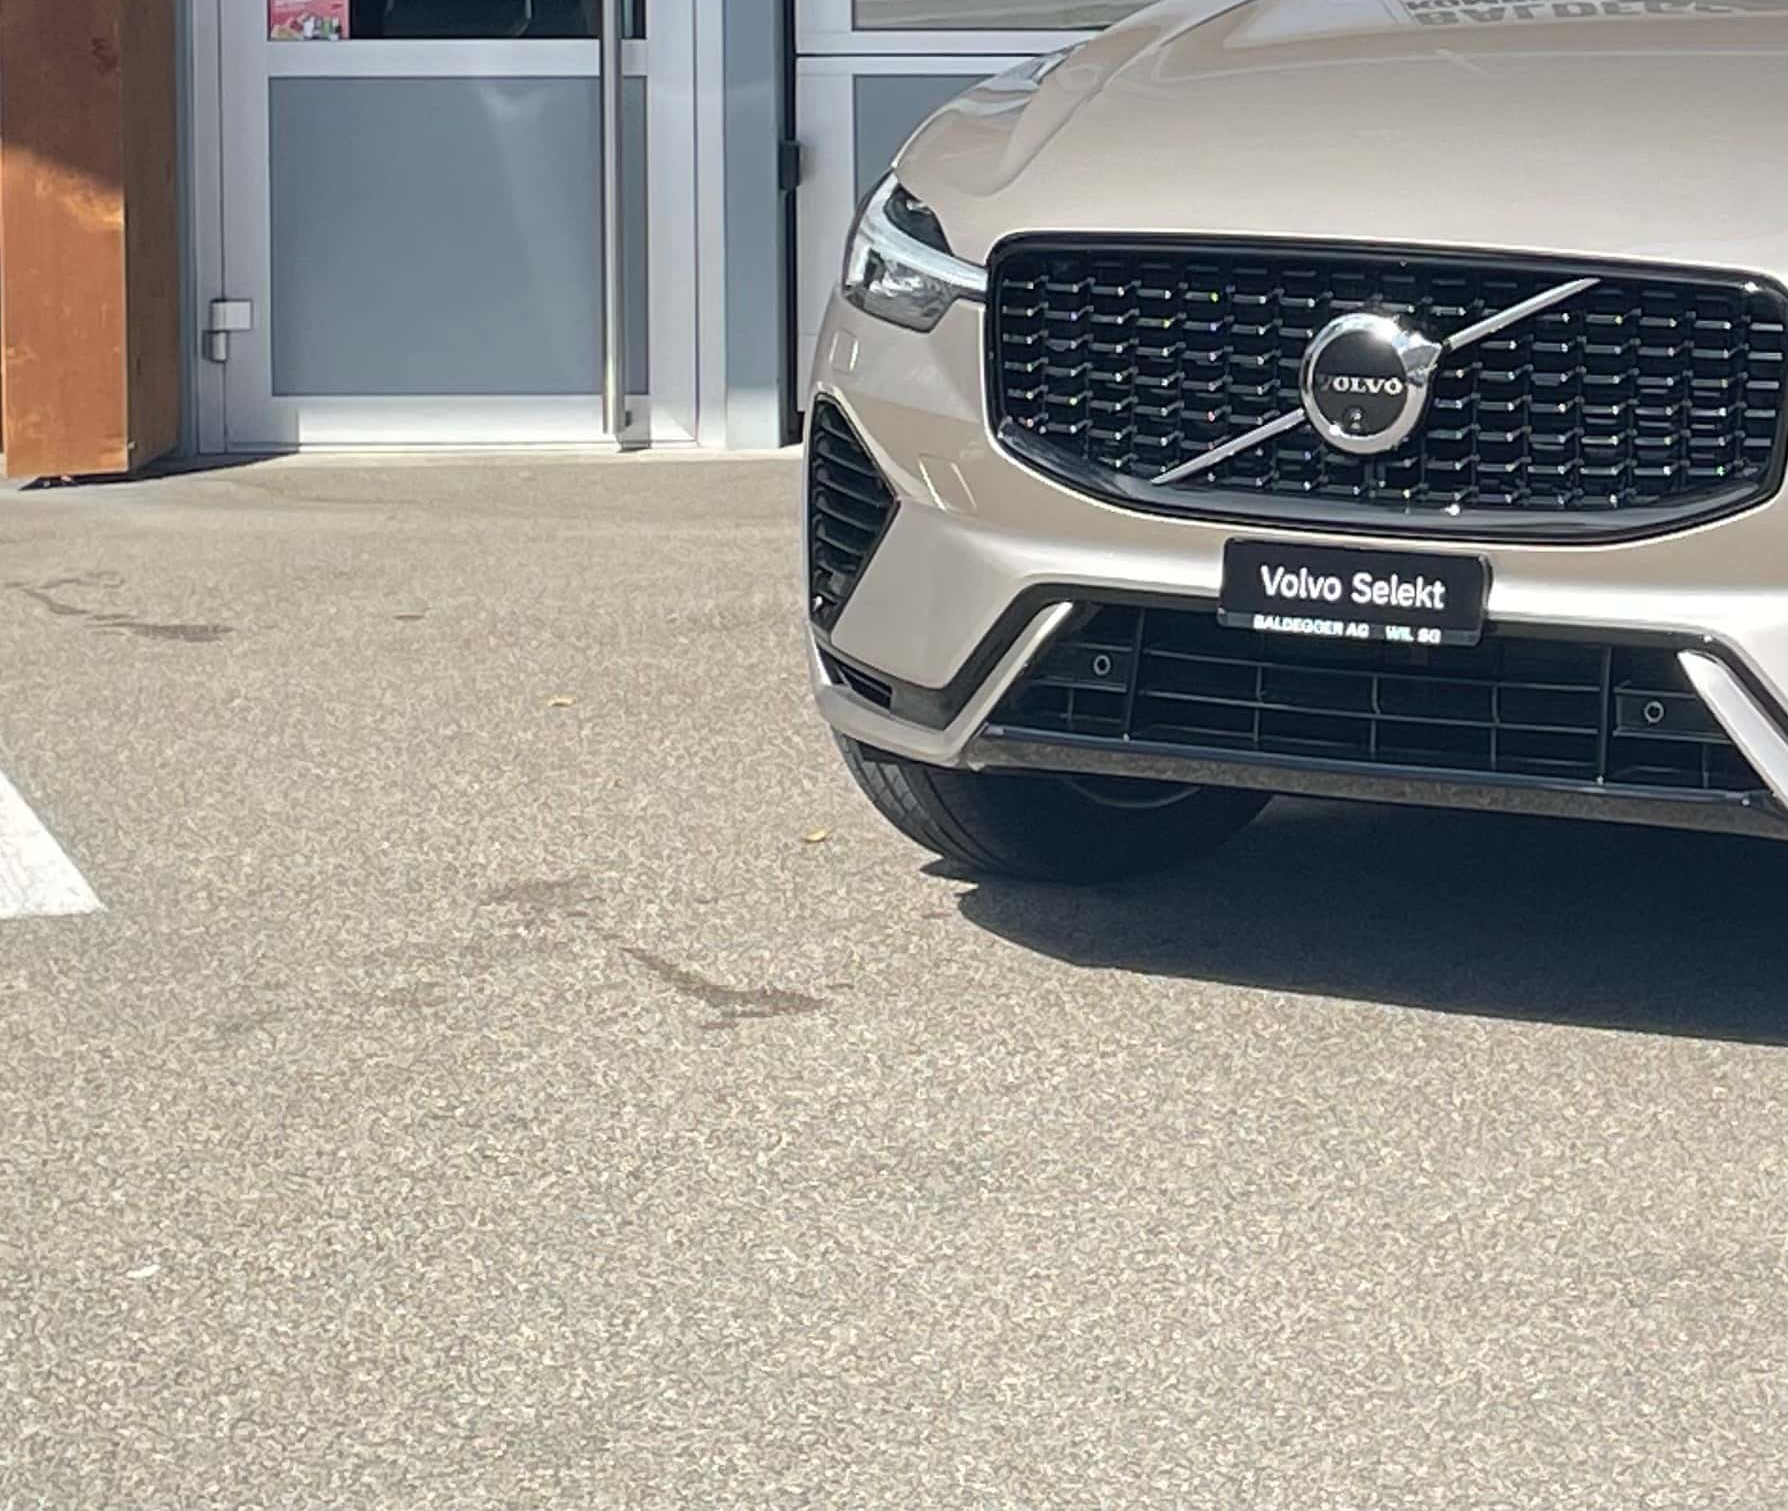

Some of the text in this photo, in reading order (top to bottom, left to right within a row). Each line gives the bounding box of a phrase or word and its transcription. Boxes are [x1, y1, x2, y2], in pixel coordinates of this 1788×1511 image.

[1260, 564, 1445, 610] Volvo Selekt
[1253, 614, 1345, 637] BALDEGGER
[1346, 621, 1370, 638] AG
